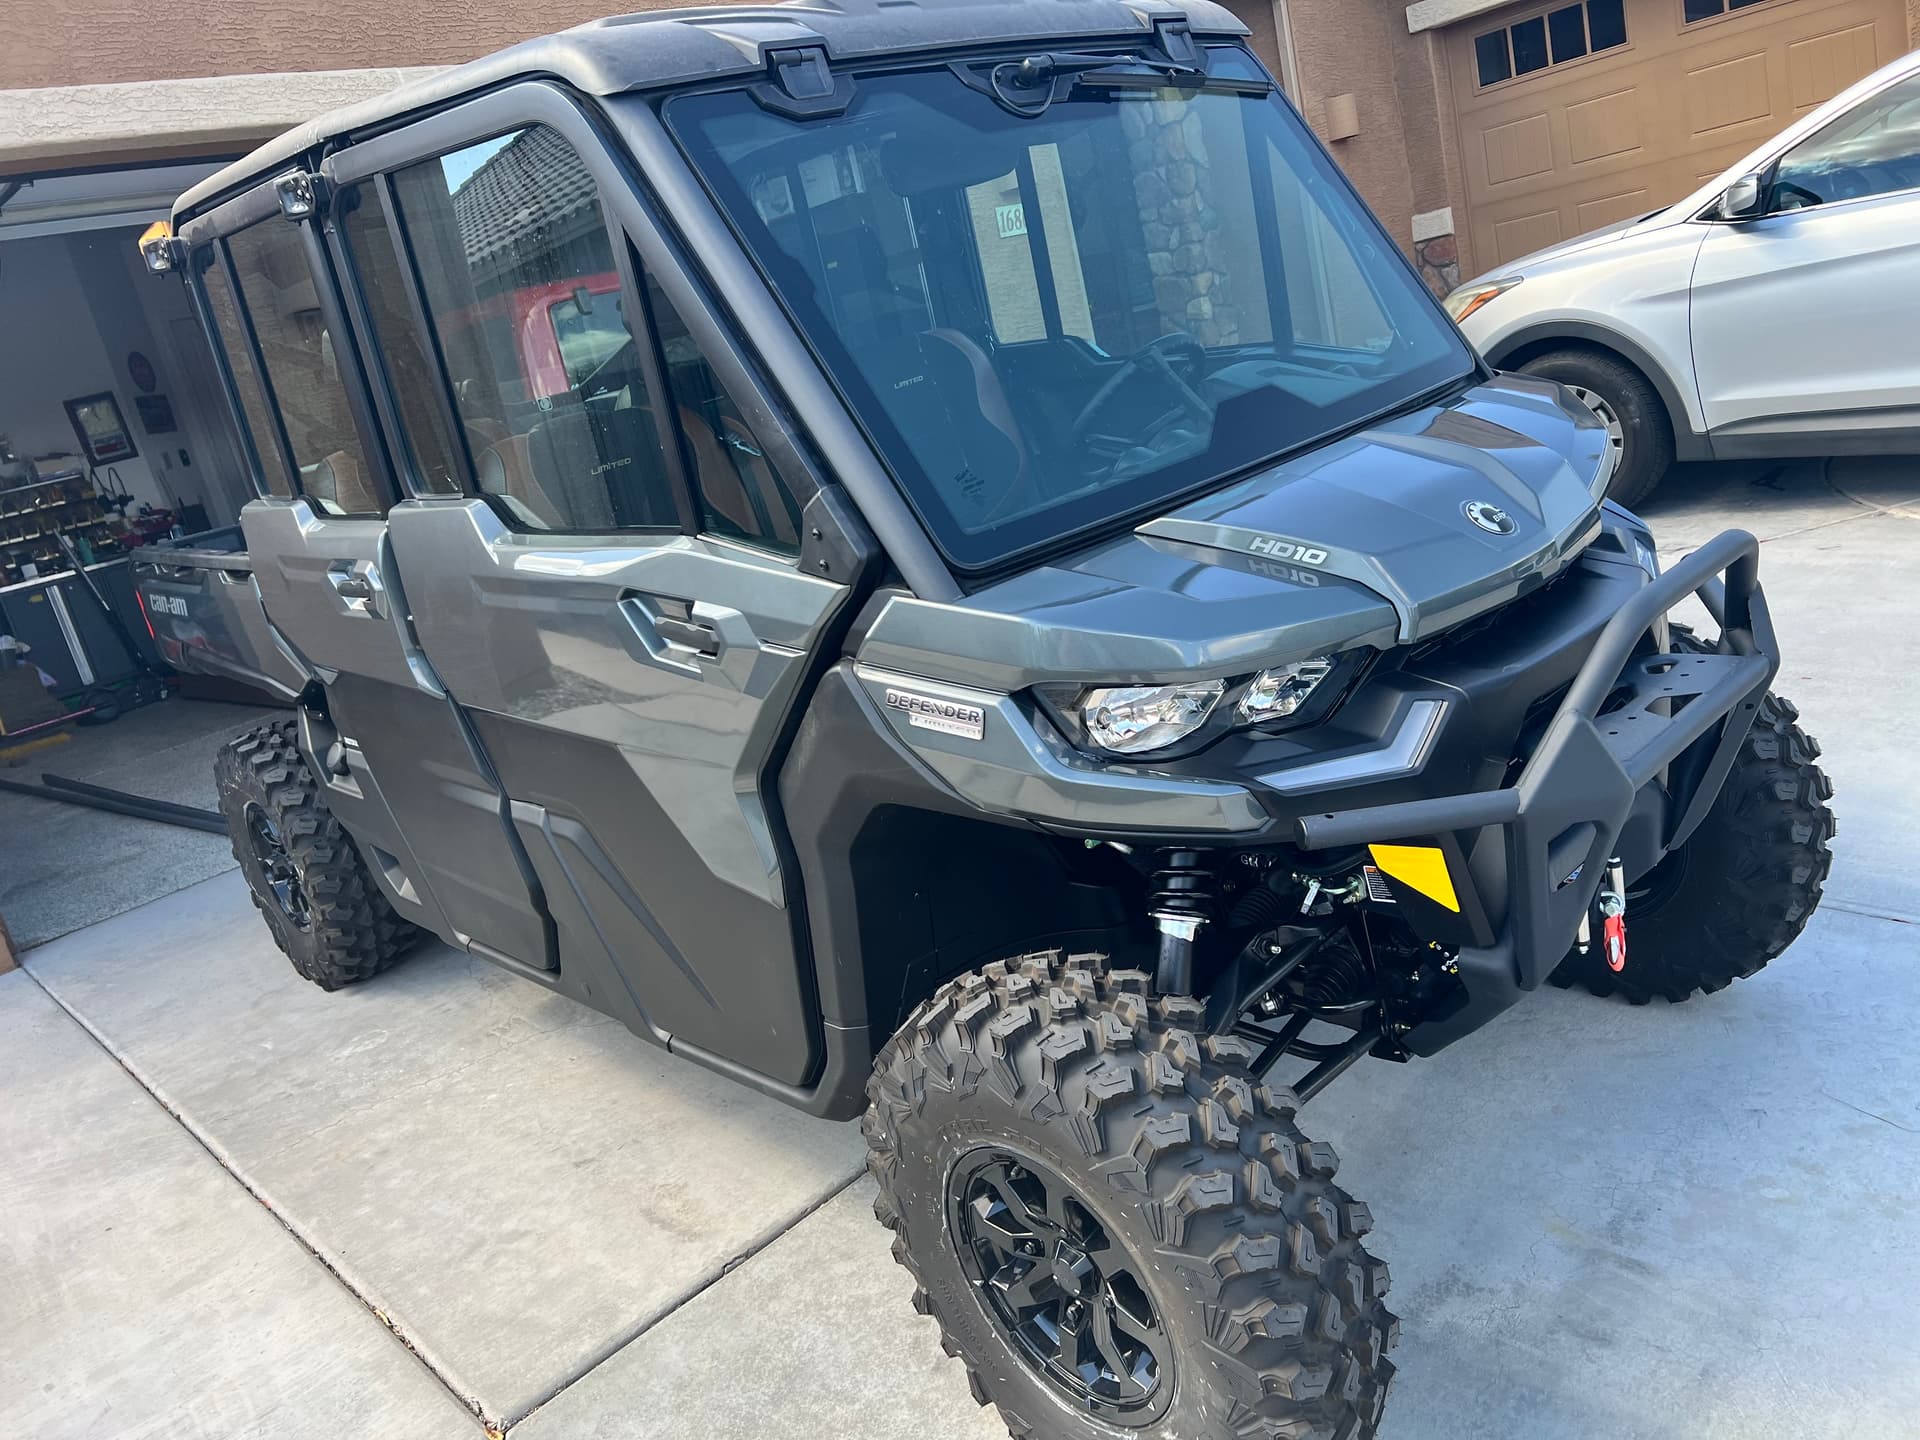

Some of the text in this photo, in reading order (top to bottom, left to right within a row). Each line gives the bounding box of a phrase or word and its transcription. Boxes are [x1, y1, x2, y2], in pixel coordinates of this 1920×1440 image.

[999, 208, 1024, 233] 168
[1249, 536, 1328, 565] HD10
[149, 594, 188, 616] can-am
[887, 693, 980, 723] DEFENDER
